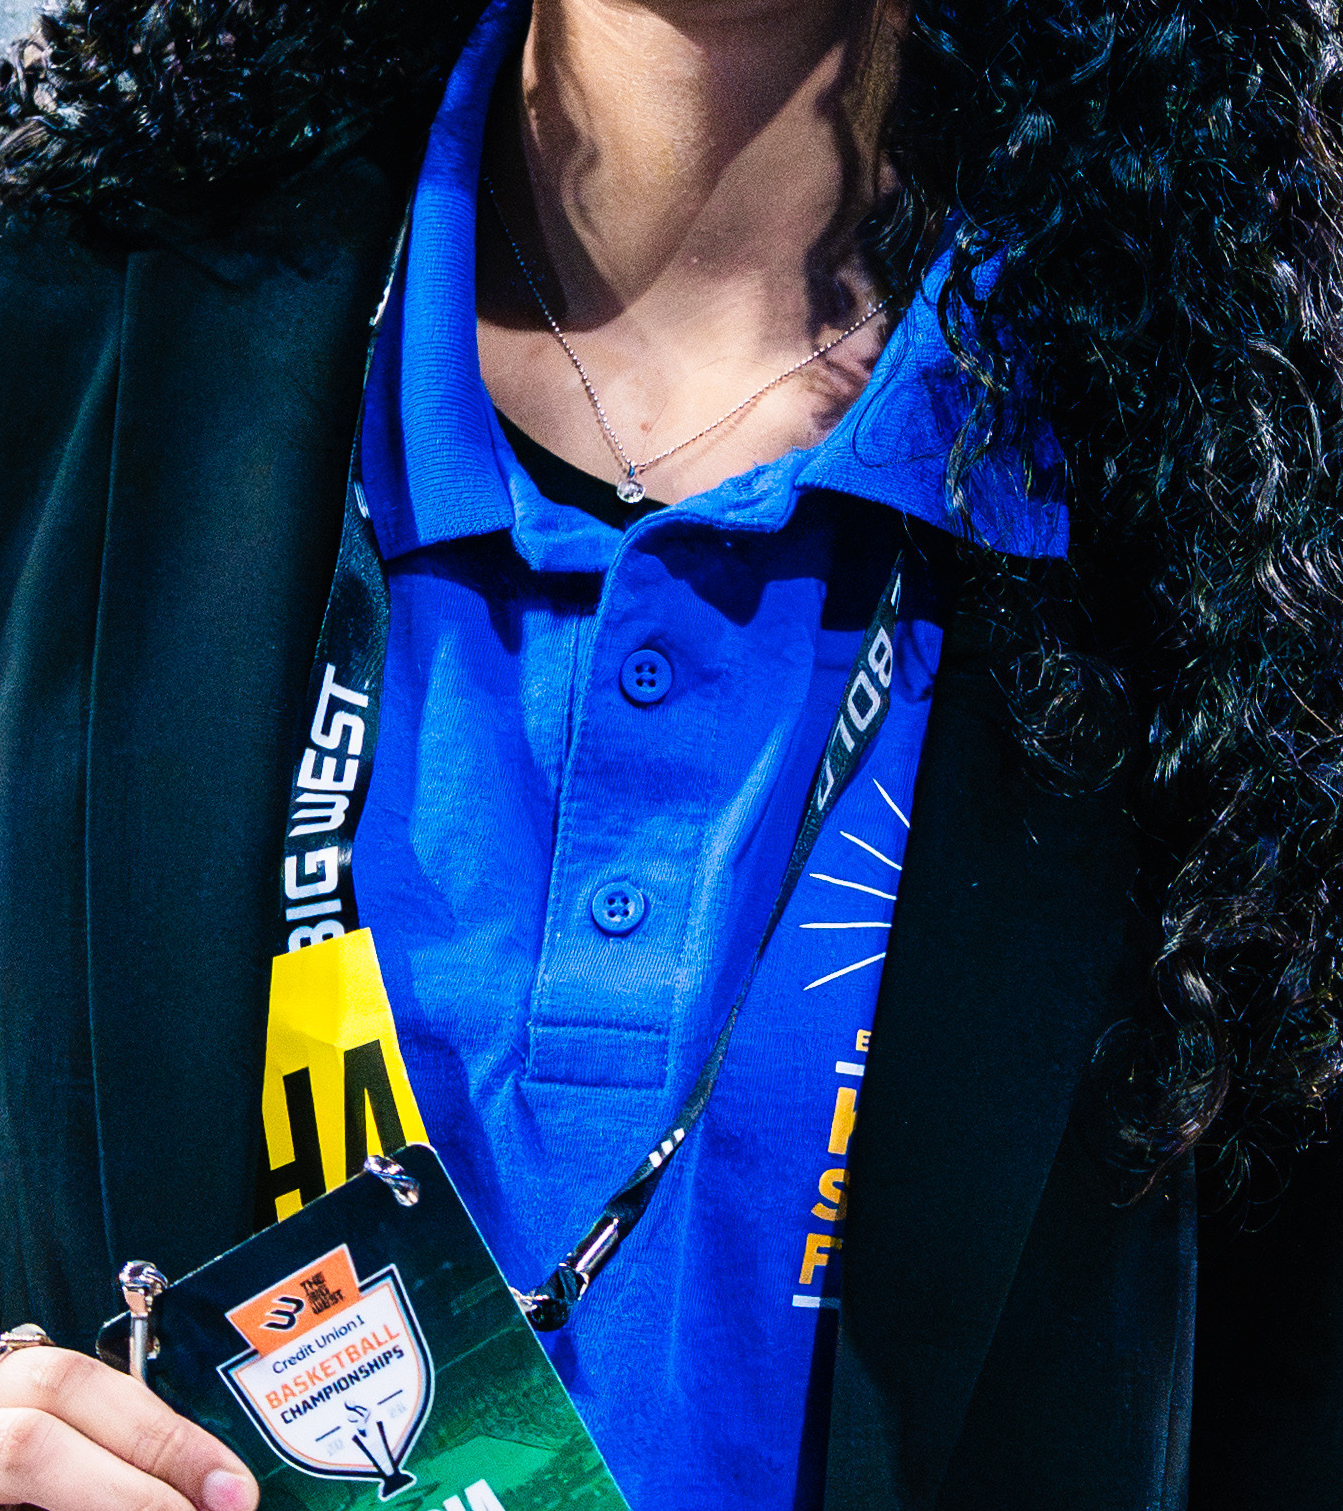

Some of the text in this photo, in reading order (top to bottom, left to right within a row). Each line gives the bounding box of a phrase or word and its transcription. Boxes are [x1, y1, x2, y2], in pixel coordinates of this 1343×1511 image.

[284, 663, 369, 953] BIG WEST
[265, 1324, 401, 1410] BASKETBALL
[272, 1344, 314, 1374] Credit
[280, 1345, 405, 1424] CHAMPIONSHIPS
